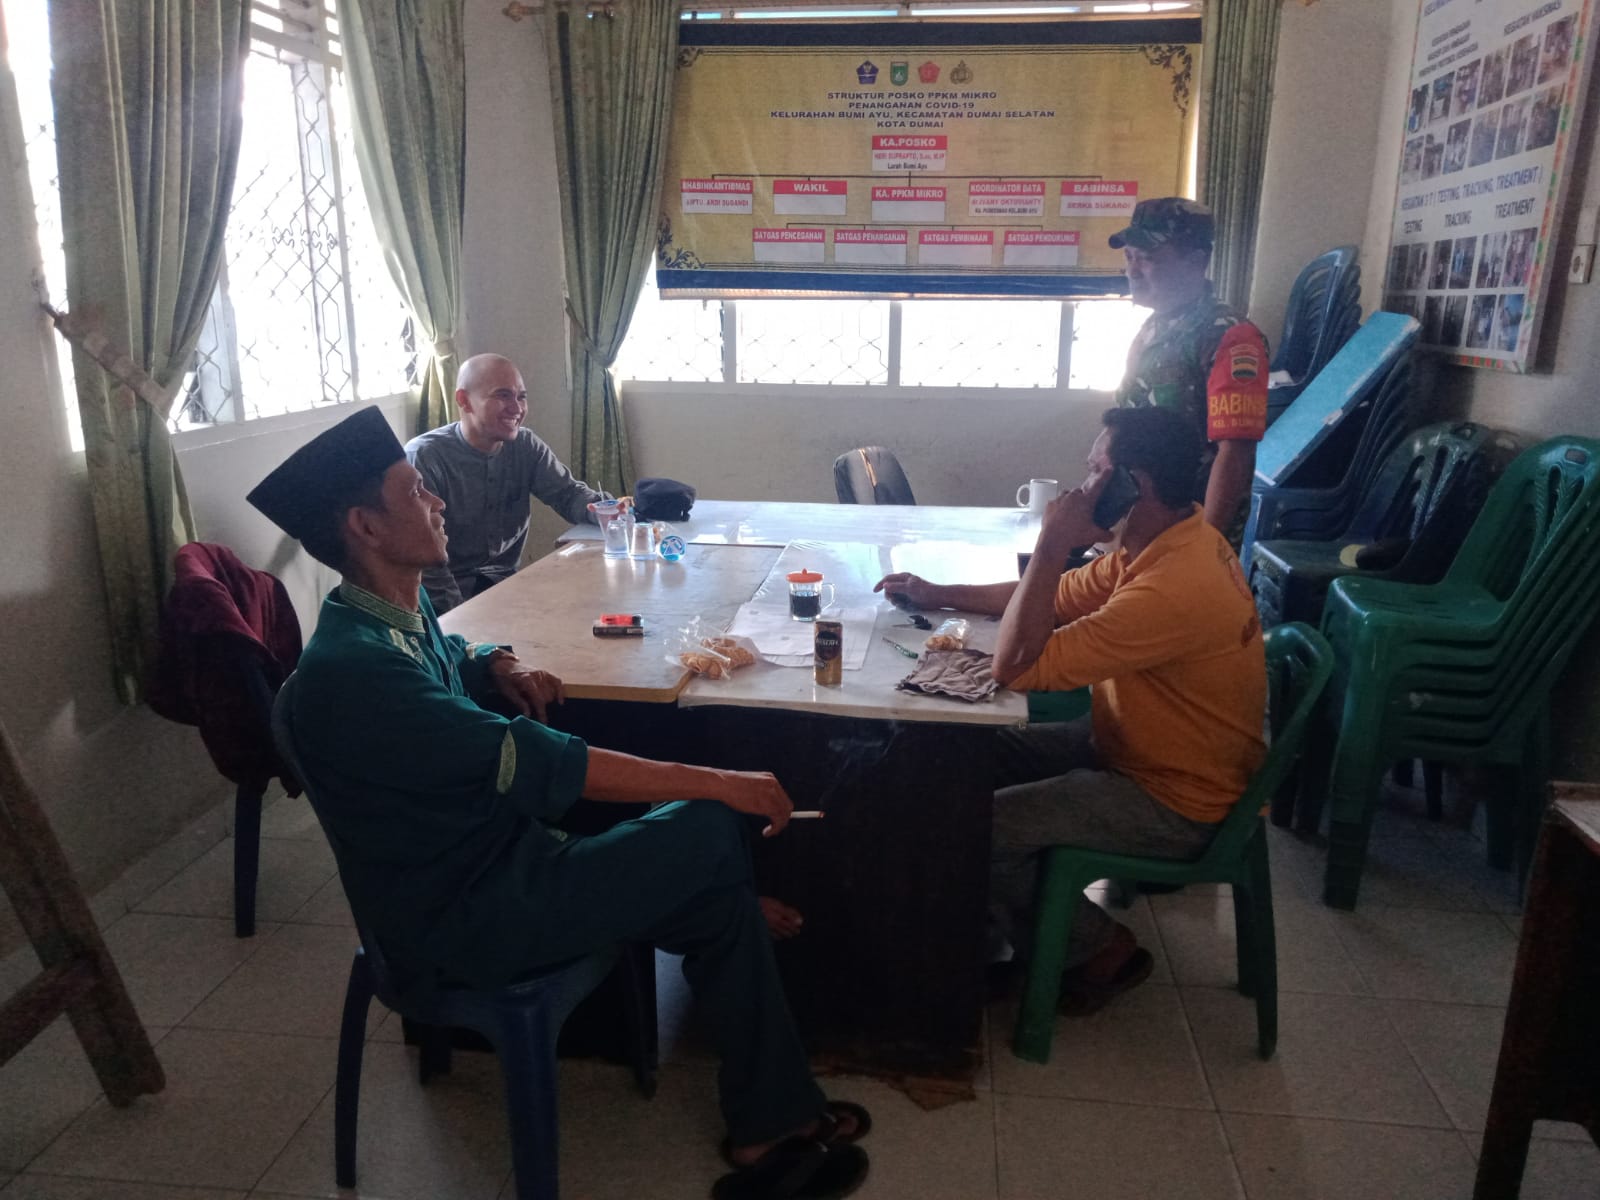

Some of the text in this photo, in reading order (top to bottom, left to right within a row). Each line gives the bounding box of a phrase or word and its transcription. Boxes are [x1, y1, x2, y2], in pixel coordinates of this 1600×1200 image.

[827, 92, 885, 100] STRUKTUR
[887, 92, 925, 100] POSKO
[928, 92, 958, 100] PPKM
[770, 111, 835, 119] KELURAHAN
[839, 111, 865, 119] BUMI
[896, 111, 964, 119] KECAMATAN
[967, 111, 1002, 119] DUMAI
[1005, 110, 1055, 118] SELATAN
[880, 138, 936, 147] KA.POSKO
[793, 183, 829, 192] WAKIL
[970, 183, 1042, 193] KOORDINATOR DATA
[1073, 184, 1126, 193] BABINSA
[875, 189, 943, 198] KA. PPKM MIKRO
[1495, 197, 1536, 219] TREATMENT
[754, 231, 780, 240] SATGAS
[836, 232, 862, 241] SATGAS
[923, 233, 949, 242] SATGAS
[1008, 233, 1033, 242] SATGAS
[1209, 393, 1266, 417] BABINS
